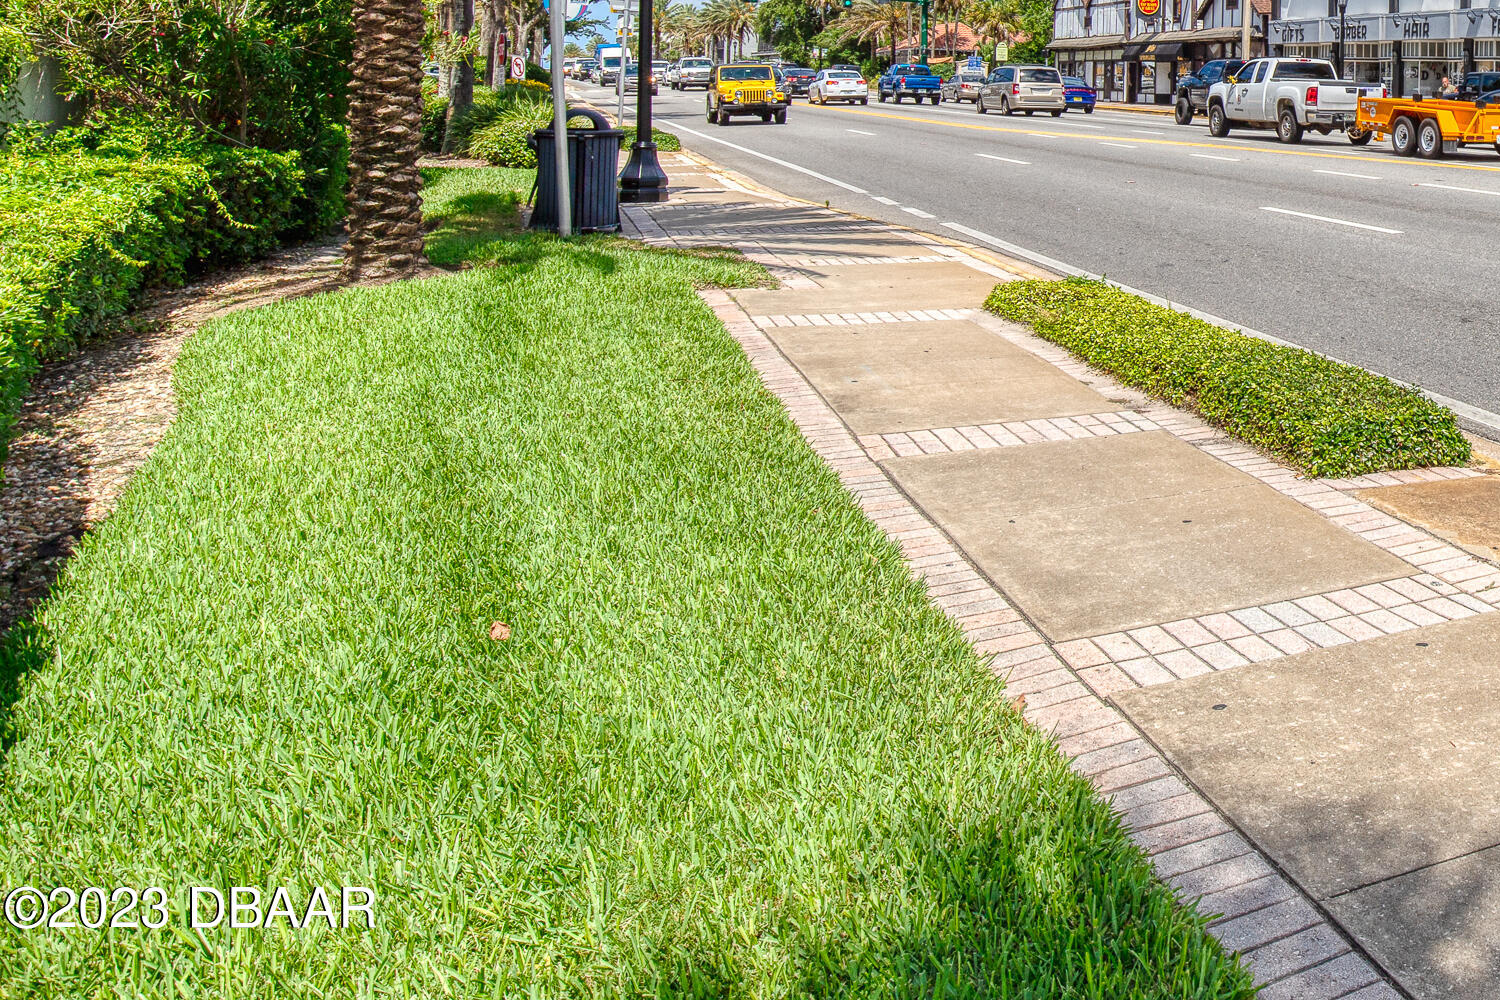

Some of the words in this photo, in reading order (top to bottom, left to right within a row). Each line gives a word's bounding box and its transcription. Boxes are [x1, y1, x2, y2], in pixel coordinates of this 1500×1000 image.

[1281, 27, 1305, 42] GIFTS
[1334, 24, 1367, 40] BRBER
[1403, 22, 1430, 38] HAIR
